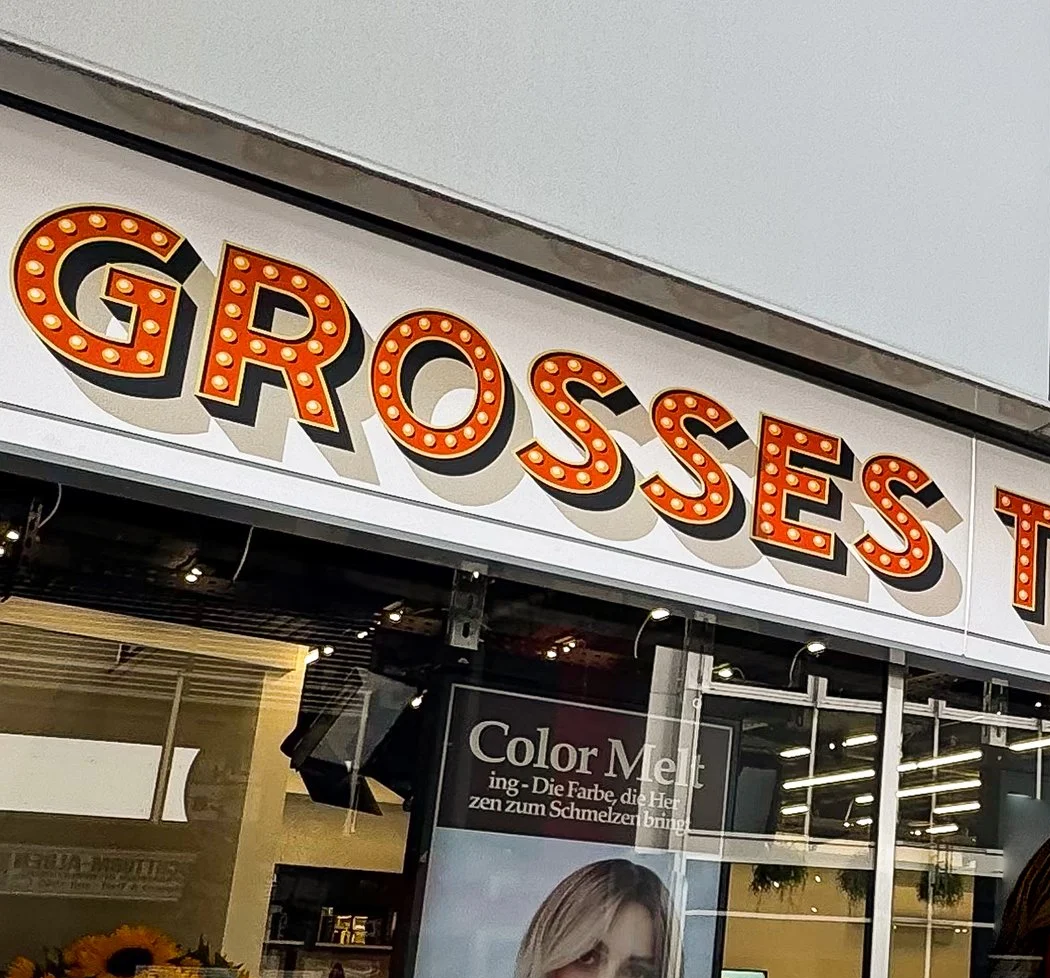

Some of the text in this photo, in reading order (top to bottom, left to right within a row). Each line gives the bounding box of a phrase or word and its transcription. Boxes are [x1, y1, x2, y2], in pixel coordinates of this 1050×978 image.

[14, 203, 946, 592] GROSSES
[468, 720, 706, 790] Color Melt
[467, 795, 502, 812] zen
[504, 799, 546, 817] zum
[549, 799, 641, 827] Schmelzen
[531, 775, 565, 797] Die
[566, 780, 618, 806] Farbe,
[619, 787, 647, 806] die
